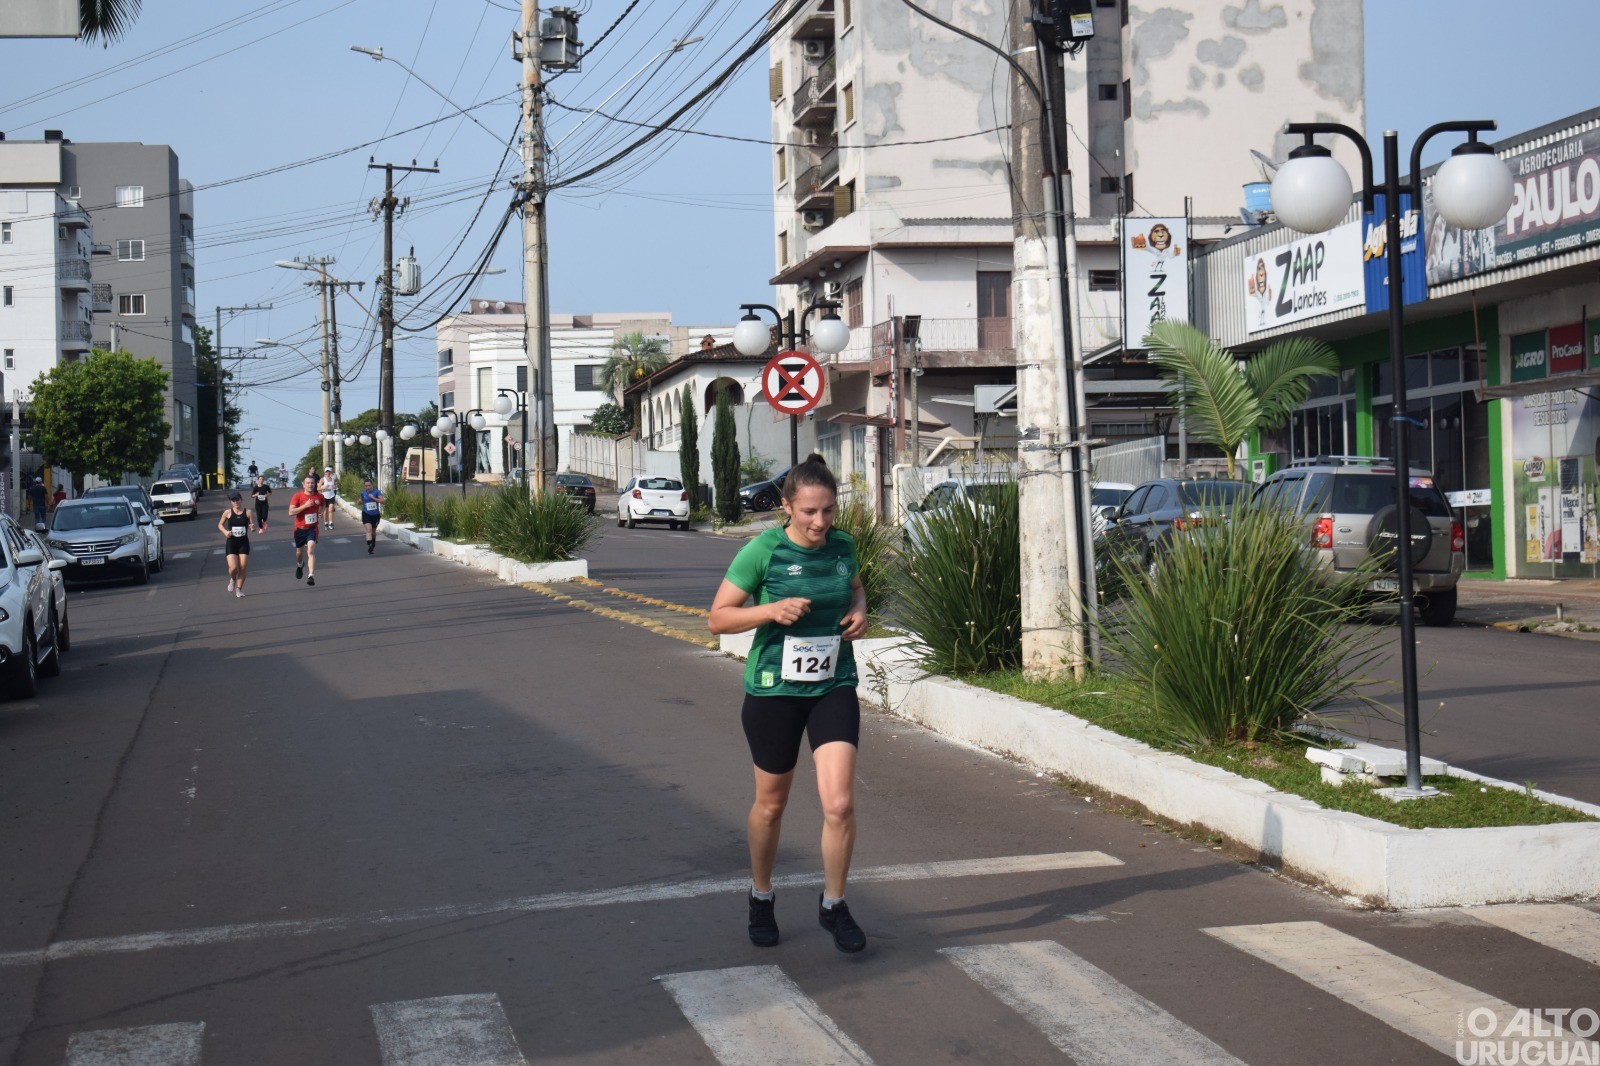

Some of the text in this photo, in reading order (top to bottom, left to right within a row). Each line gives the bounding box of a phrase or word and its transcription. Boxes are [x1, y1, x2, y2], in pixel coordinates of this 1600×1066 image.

[1519, 139, 1584, 175] AGROPECUÁRIA
[1506, 158, 1600, 235] PAULO
[1516, 245, 1537, 260] MINERAIS
[1541, 242, 1550, 254] PET
[1554, 233, 1581, 250] FERRAGENS
[1275, 240, 1325, 318] ZAAP
[1147, 273, 1167, 336] ZAA
[1293, 286, 1327, 313] Lanches
[1551, 341, 1585, 359] ProCaval
[1593, 334, 1600, 355] B
[1514, 350, 1544, 368] AGRO
[1562, 509, 1575, 519] milk
[792, 644, 814, 652] Sesc
[792, 656, 831, 673] 124
